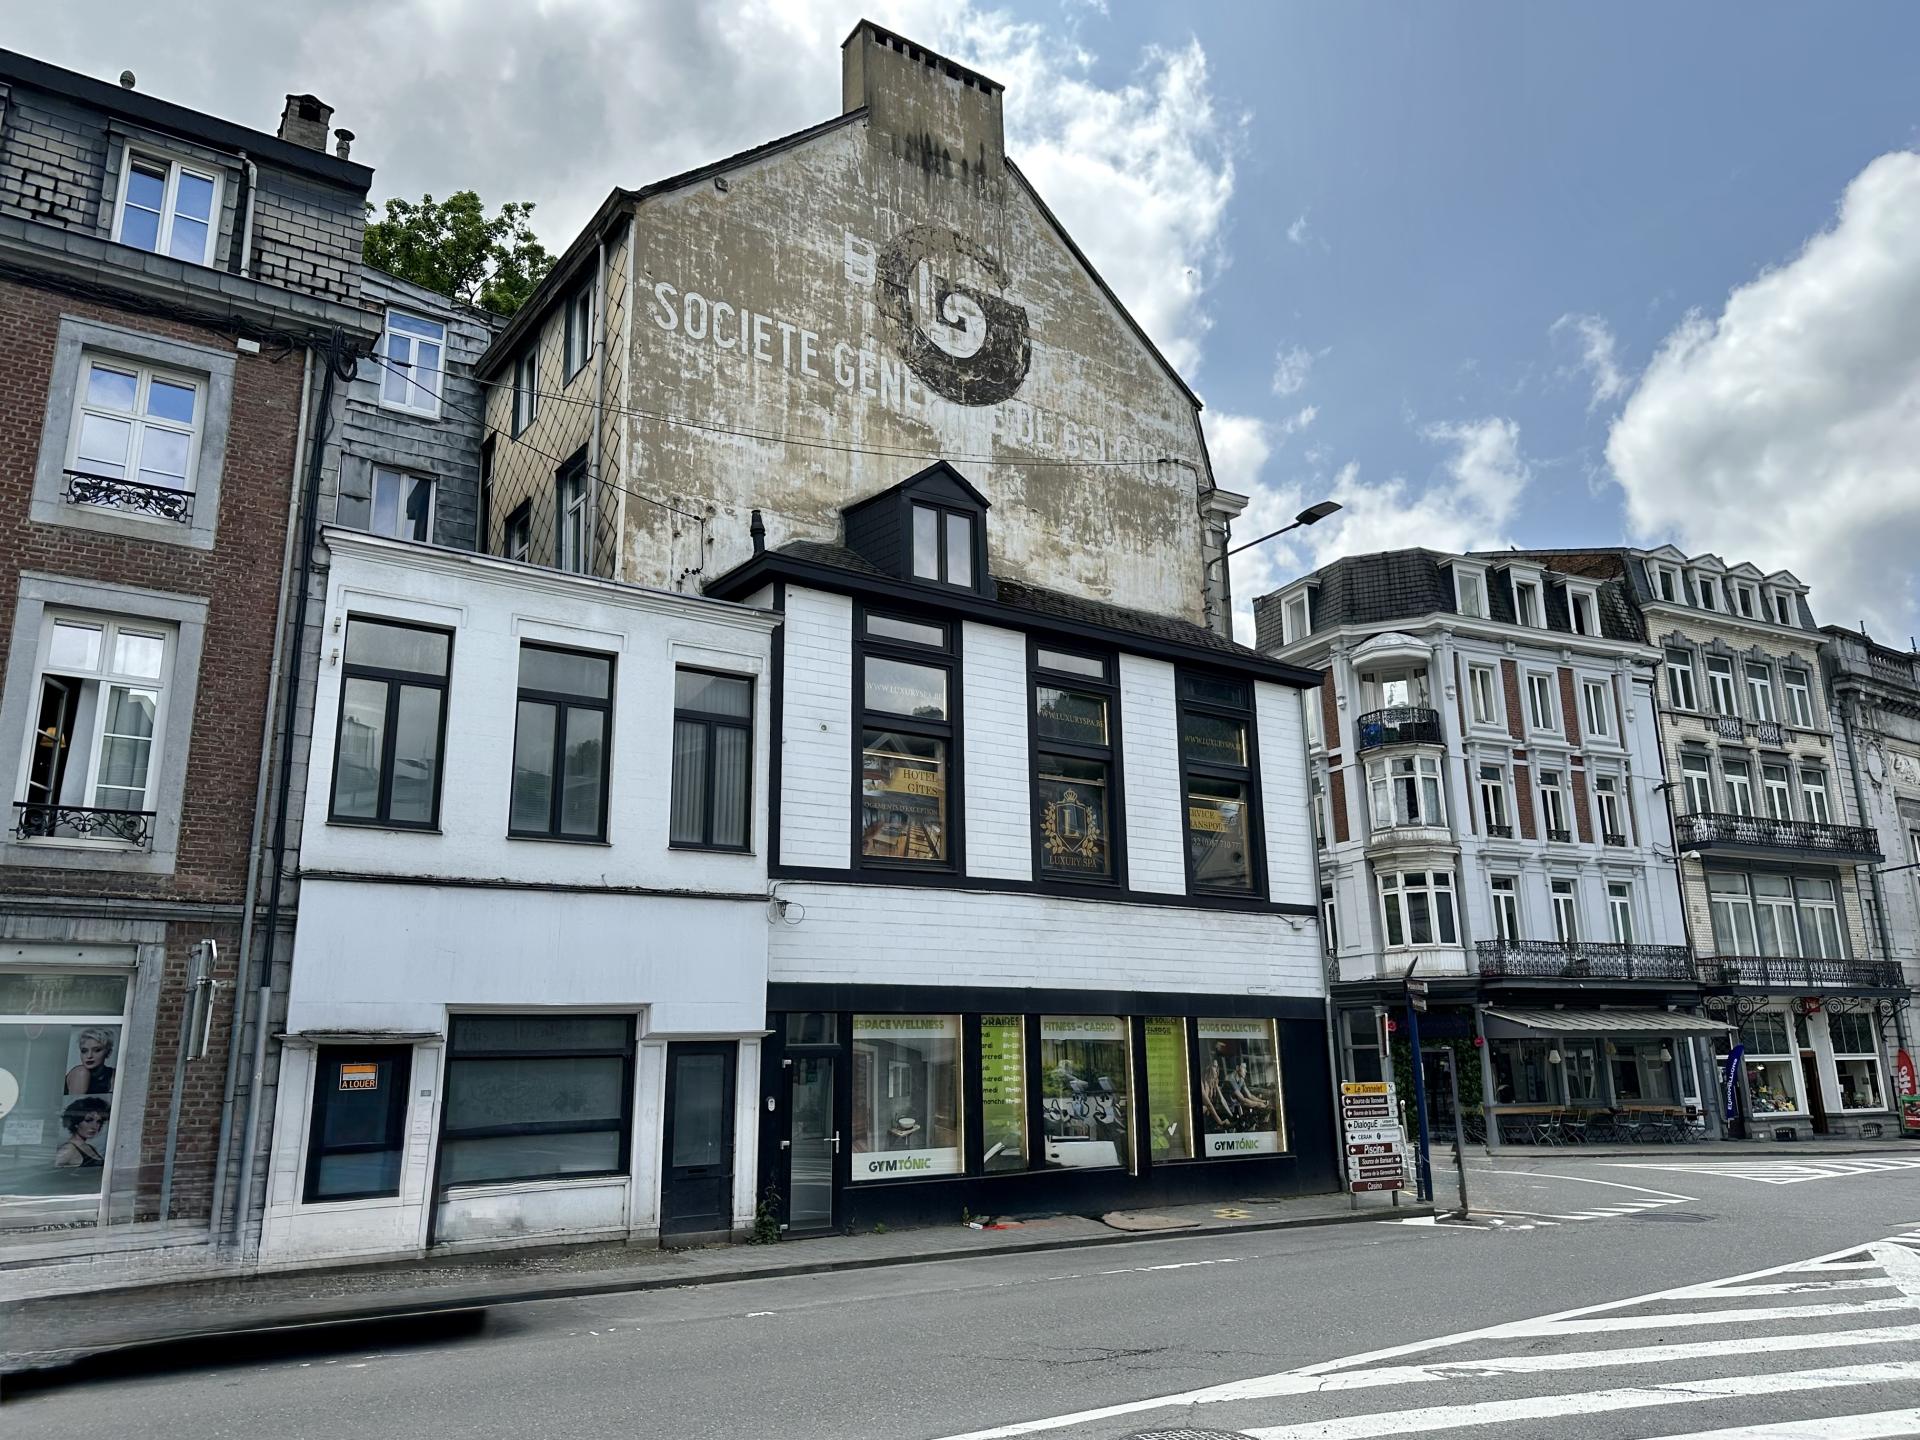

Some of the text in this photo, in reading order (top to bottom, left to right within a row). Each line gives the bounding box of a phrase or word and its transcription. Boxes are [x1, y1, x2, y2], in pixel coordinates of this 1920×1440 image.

[653, 281, 820, 379] SOCIETE
[903, 769, 938, 783] HOTEL
[1063, 809, 1080, 839] L
[1049, 855, 1097, 868] LUXURY SPA
[853, 1018, 945, 1030] ESPACE WELLNESS
[981, 1015, 1021, 1026] ORAIRES
[1044, 1022, 1076, 1032] FITNESS
[1084, 1022, 1116, 1032] CARDIO
[1199, 1022, 1262, 1033] OURS COLLECTIFS
[341, 1079, 376, 1089] A LOUER
[1355, 1084, 1383, 1093] Le Tonnelet
[1214, 1138, 1259, 1151] GYMTÓNIC
[1364, 1143, 1385, 1155] Piscine
[868, 1156, 931, 1173] GYMTÓNIC
[1367, 1182, 1383, 1190] Casino
